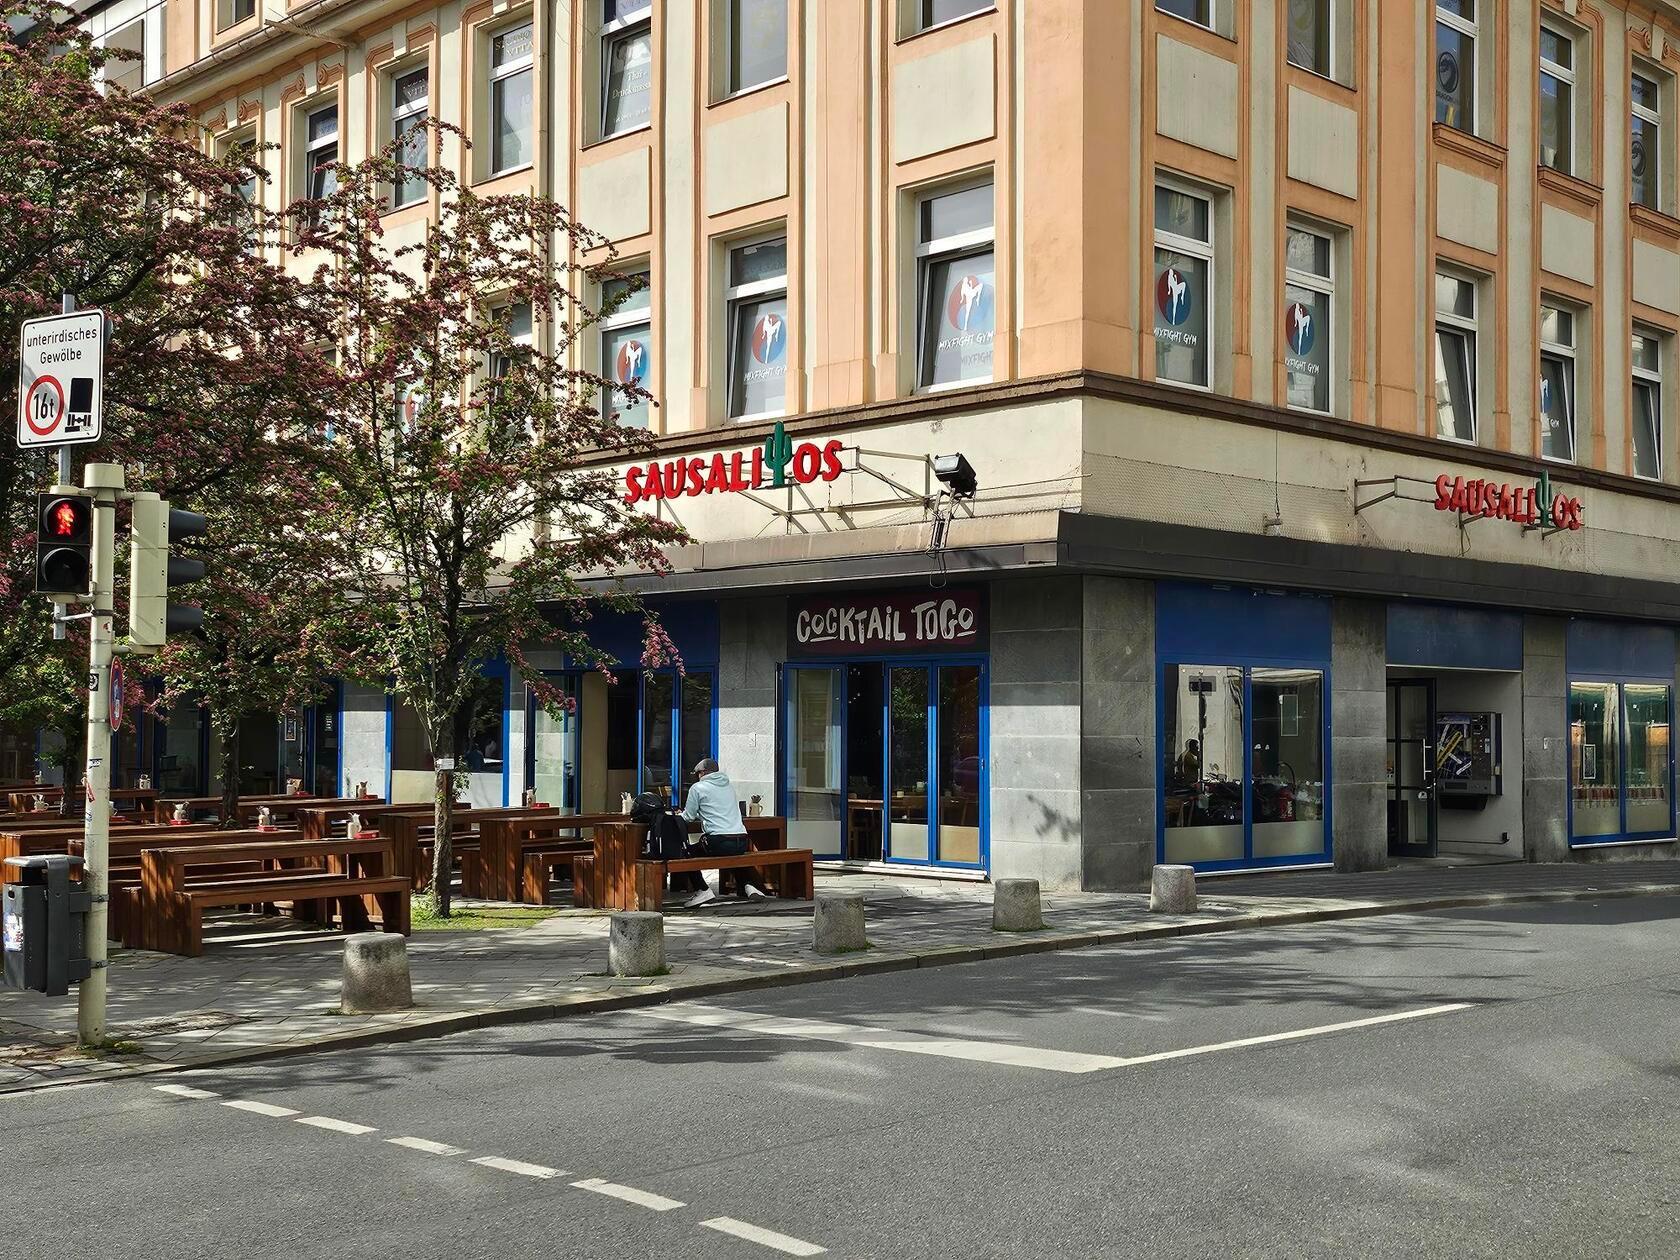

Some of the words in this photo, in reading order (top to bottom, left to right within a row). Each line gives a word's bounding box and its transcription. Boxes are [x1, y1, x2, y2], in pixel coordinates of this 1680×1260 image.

[27, 327, 97, 347] unterirdisches
[938, 333, 975, 350] MIXFIGHT
[1183, 333, 1197, 346] GYM
[40, 348, 82, 365] Gewölbe
[1307, 362, 1320, 375] GYM
[33, 393, 55, 420] 16t
